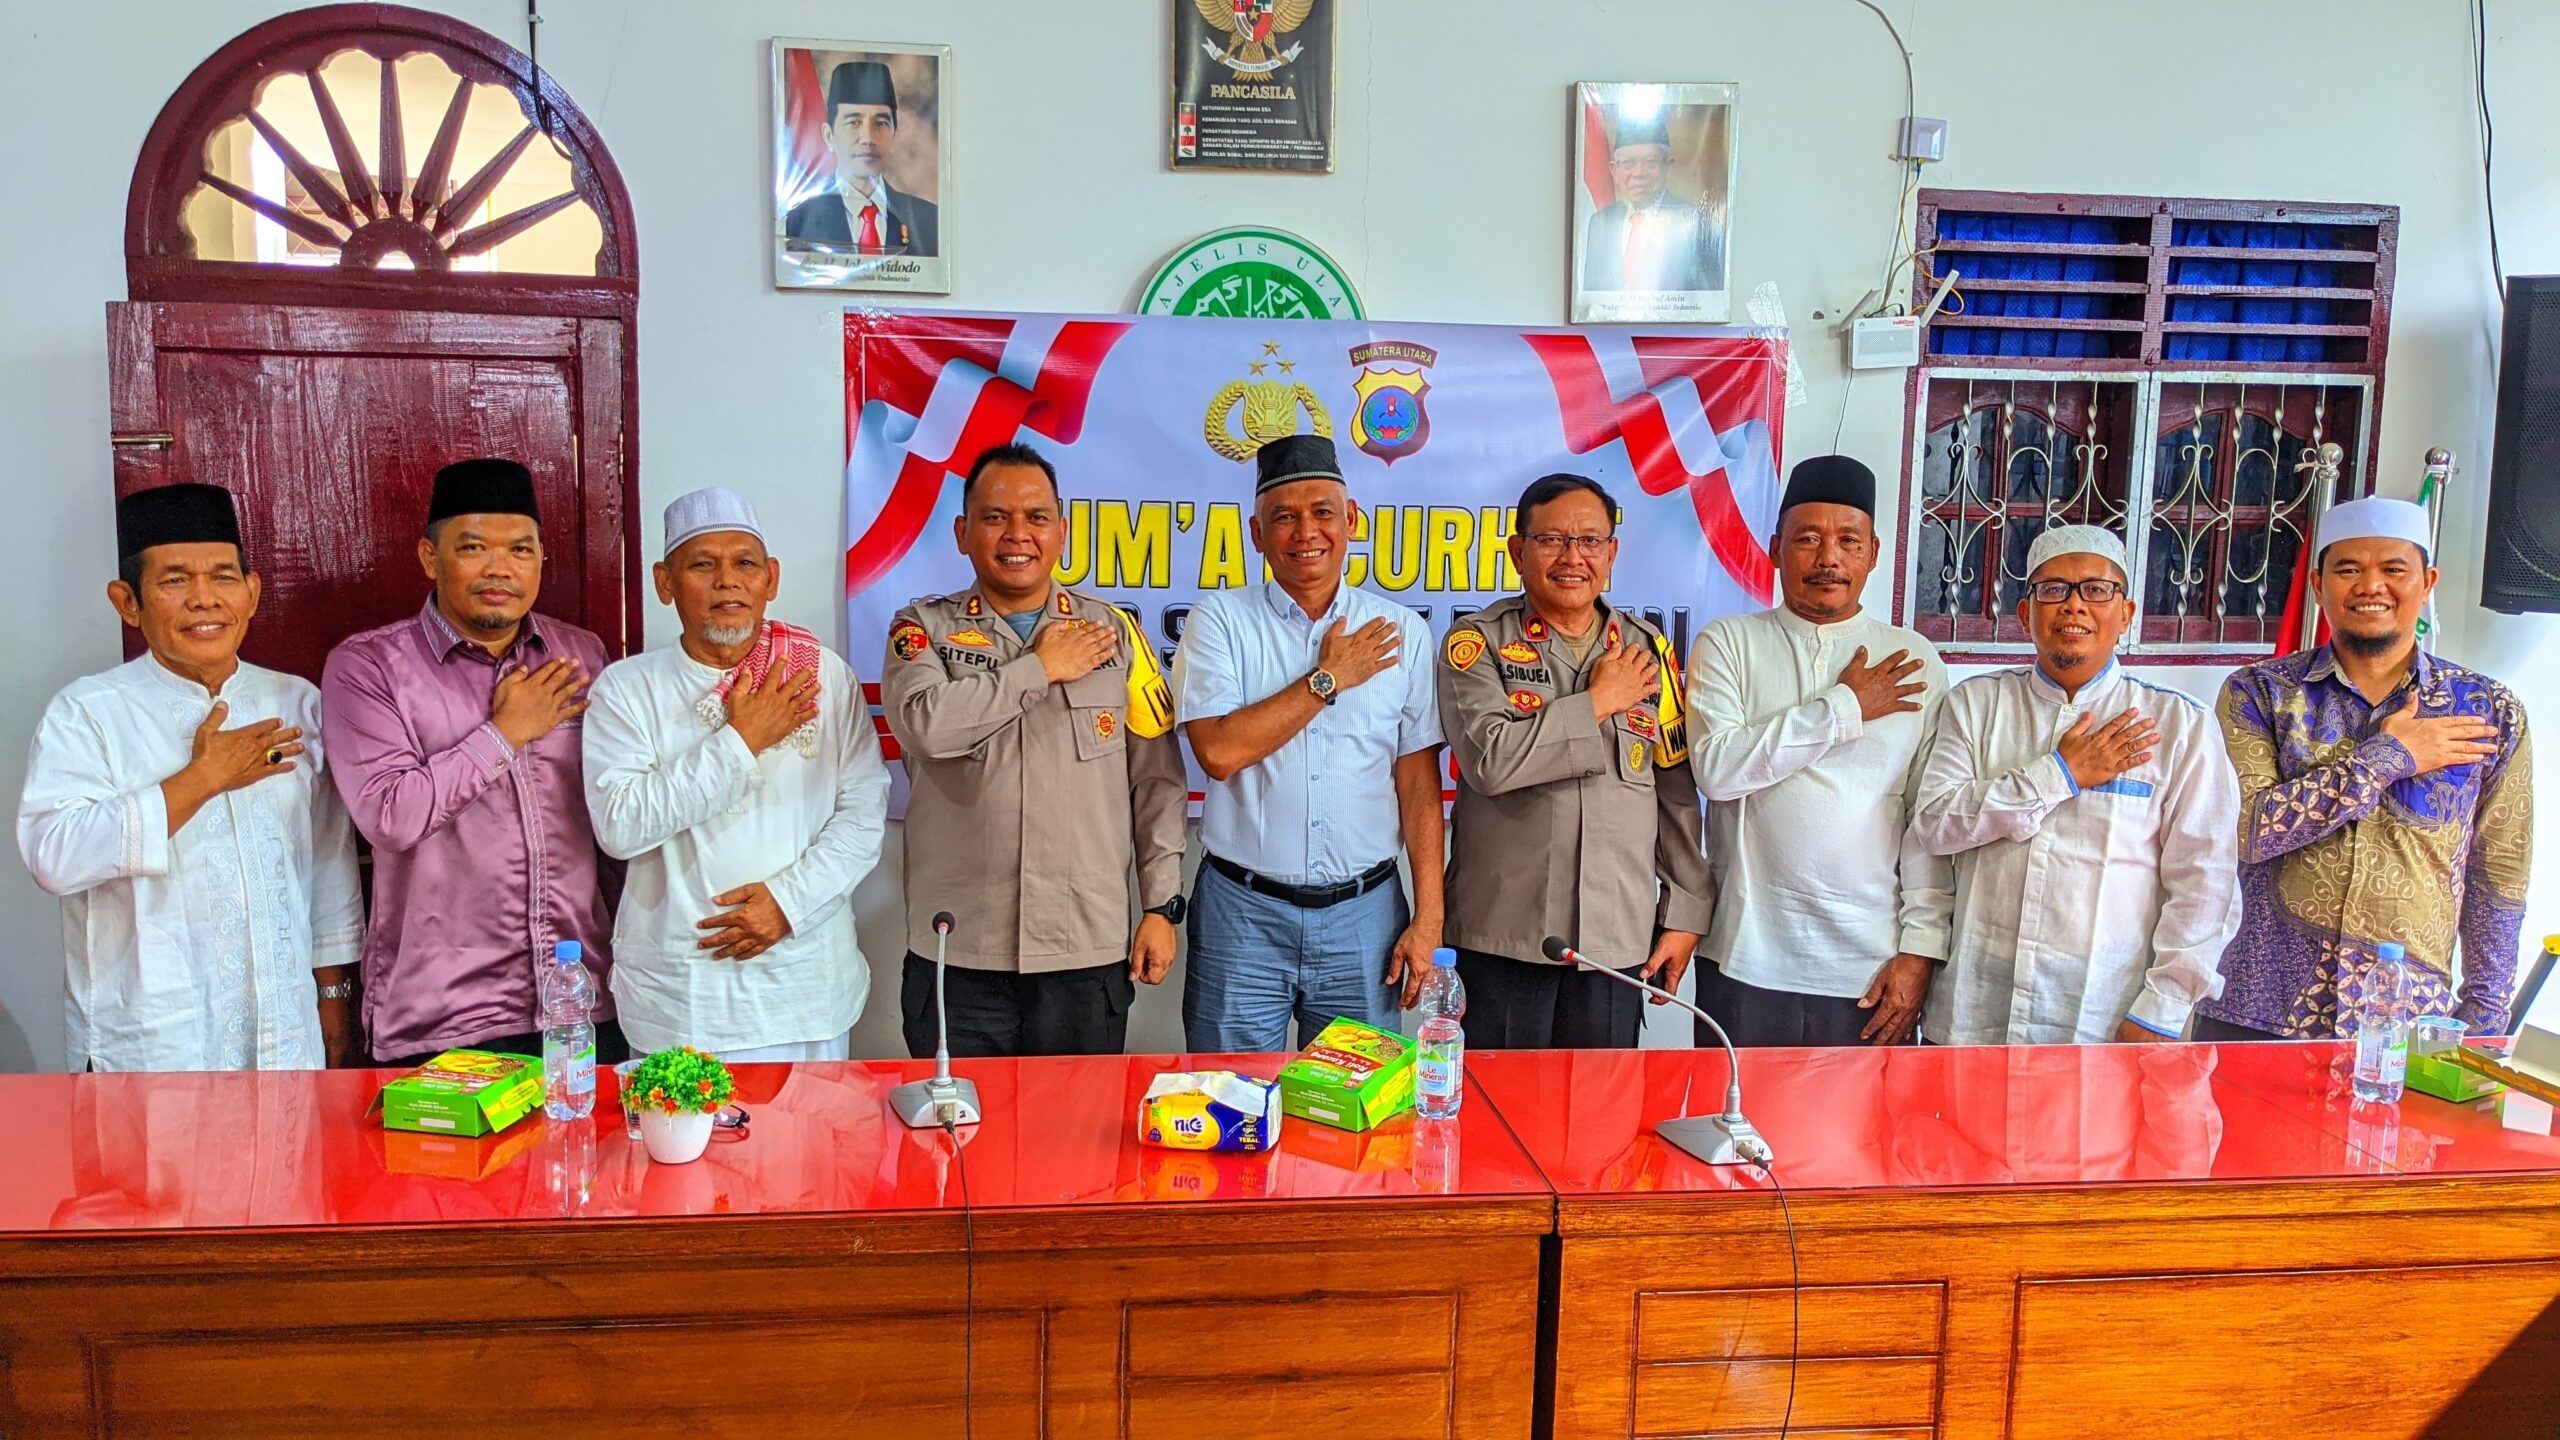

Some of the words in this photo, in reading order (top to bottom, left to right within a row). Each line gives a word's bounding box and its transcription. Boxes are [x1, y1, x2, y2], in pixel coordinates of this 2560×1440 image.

[1211, 84, 1296, 100] PANCASILA
[876, 259, 921, 274] Widodo
[877, 274, 911, 283] Indonesia
[1160, 243, 1267, 308] AJELIS
[1353, 346, 1402, 362] SUMATERA
[1403, 346, 1432, 364] UTARA
[940, 646, 999, 671] SITEPU
[1345, 1062, 1368, 1072] Roti
[1427, 1065, 1437, 1073] Le
[1419, 1069, 1449, 1081] Minerale
[959, 1110, 966, 1119] 2
